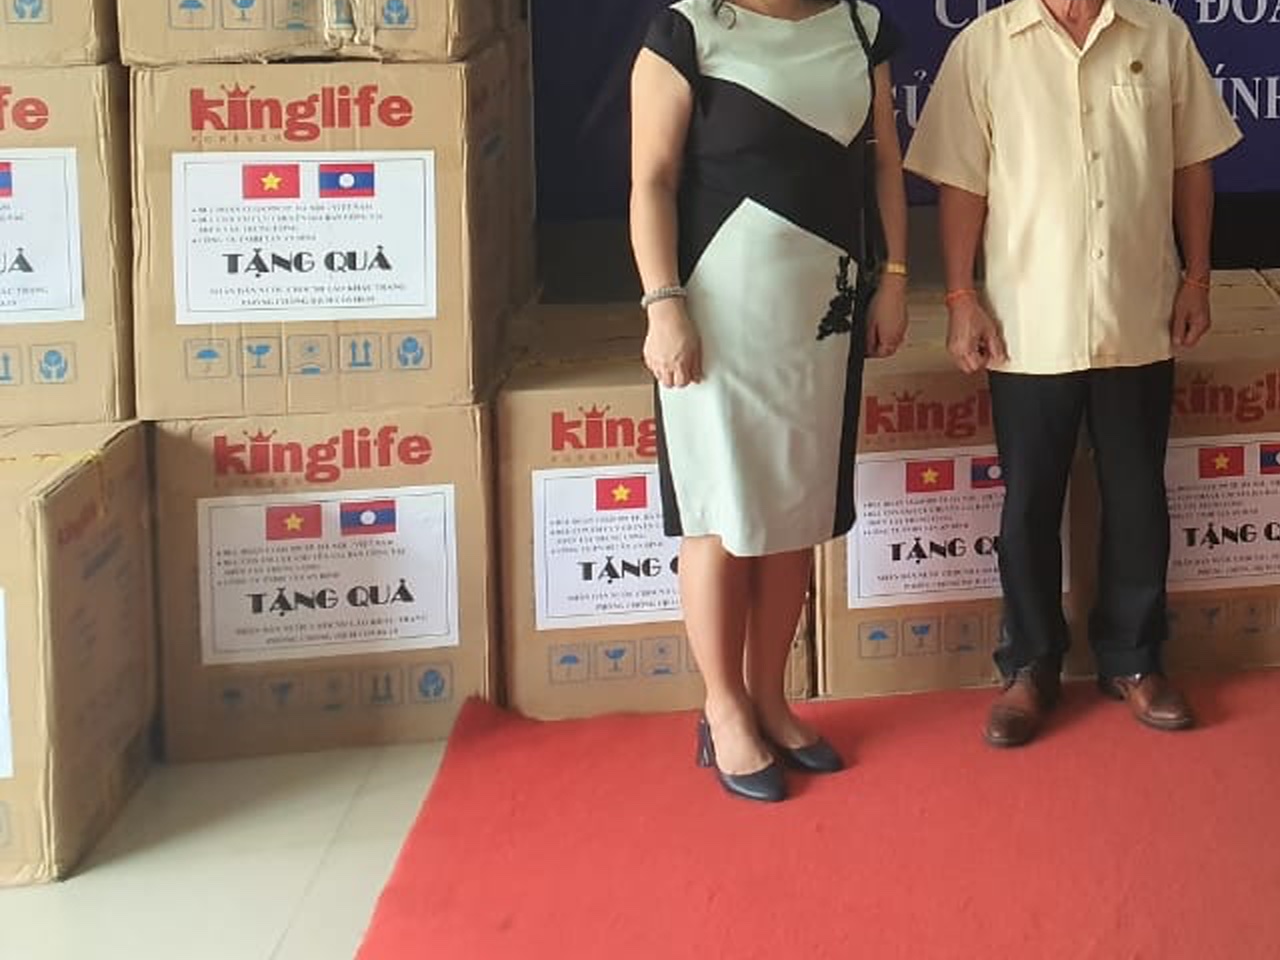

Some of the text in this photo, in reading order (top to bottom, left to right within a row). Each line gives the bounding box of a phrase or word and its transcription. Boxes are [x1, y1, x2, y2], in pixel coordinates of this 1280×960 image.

[189, 84, 413, 142] kinglife
[222, 248, 315, 278] TẶNG
[864, 392, 991, 438] kingl
[551, 406, 658, 458] king
[212, 426, 433, 484] kinglife
[888, 536, 967, 564] TẶNG
[1183, 522, 1258, 549] TẶNG
[577, 556, 662, 584] TẶNG
[247, 587, 339, 617] TẶNG
